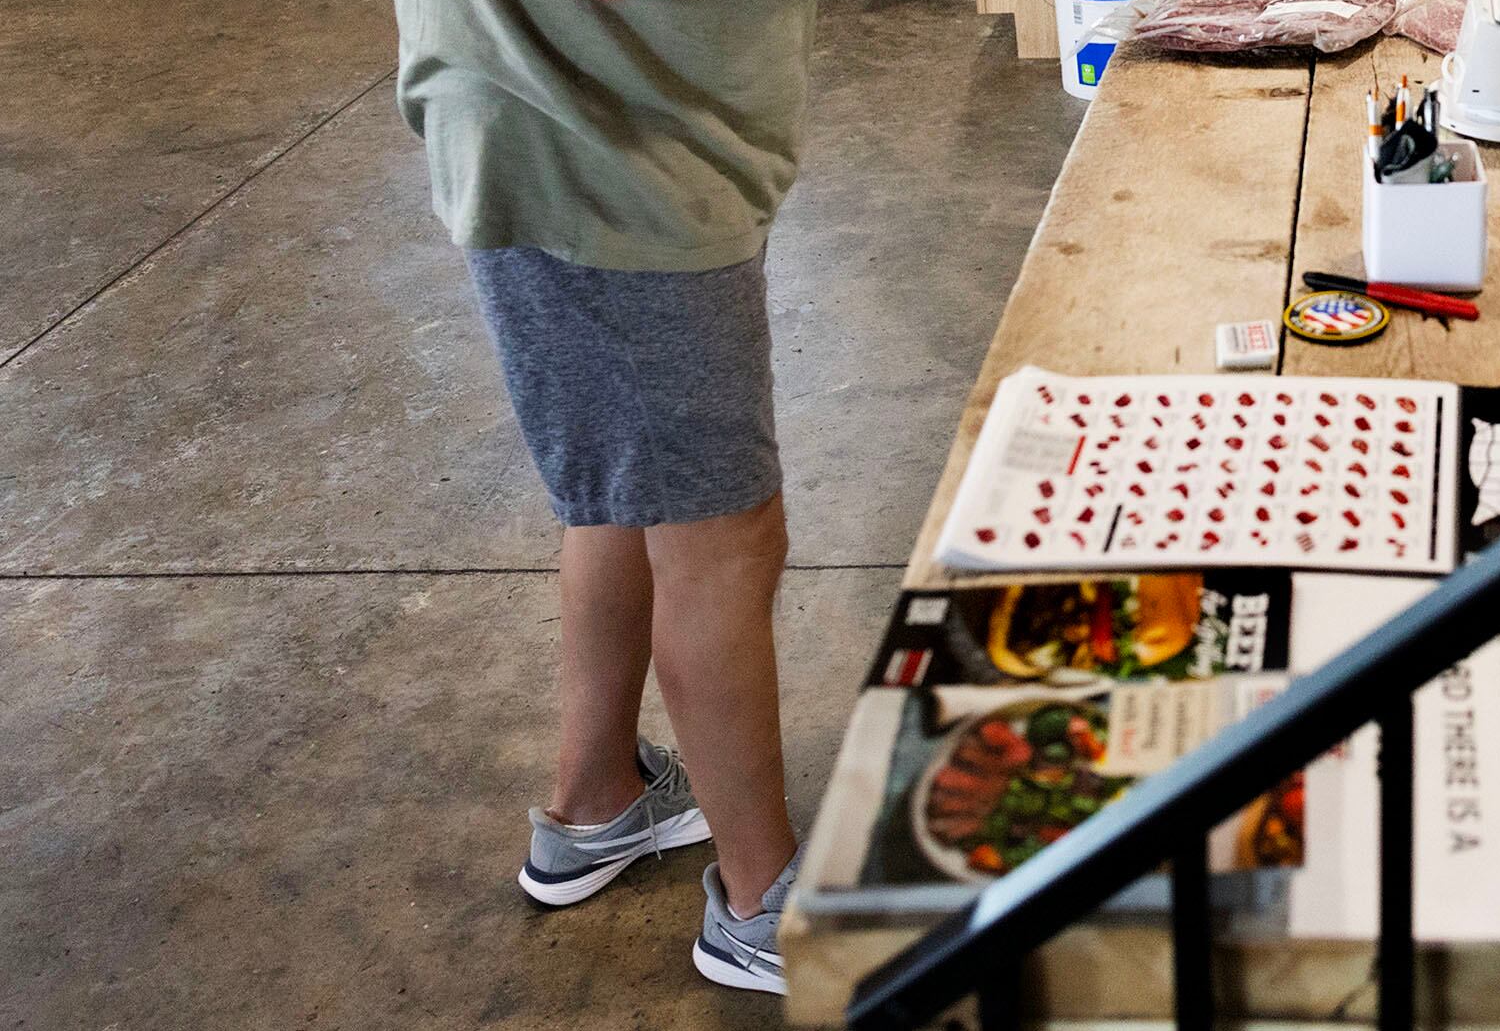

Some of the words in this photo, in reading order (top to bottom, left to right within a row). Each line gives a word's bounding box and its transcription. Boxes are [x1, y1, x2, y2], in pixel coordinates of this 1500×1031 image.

[1224, 593, 1270, 672] BEEF
[1446, 709, 1478, 786] THERE
[1448, 795, 1481, 821] IS
[1449, 832, 1482, 852] A
